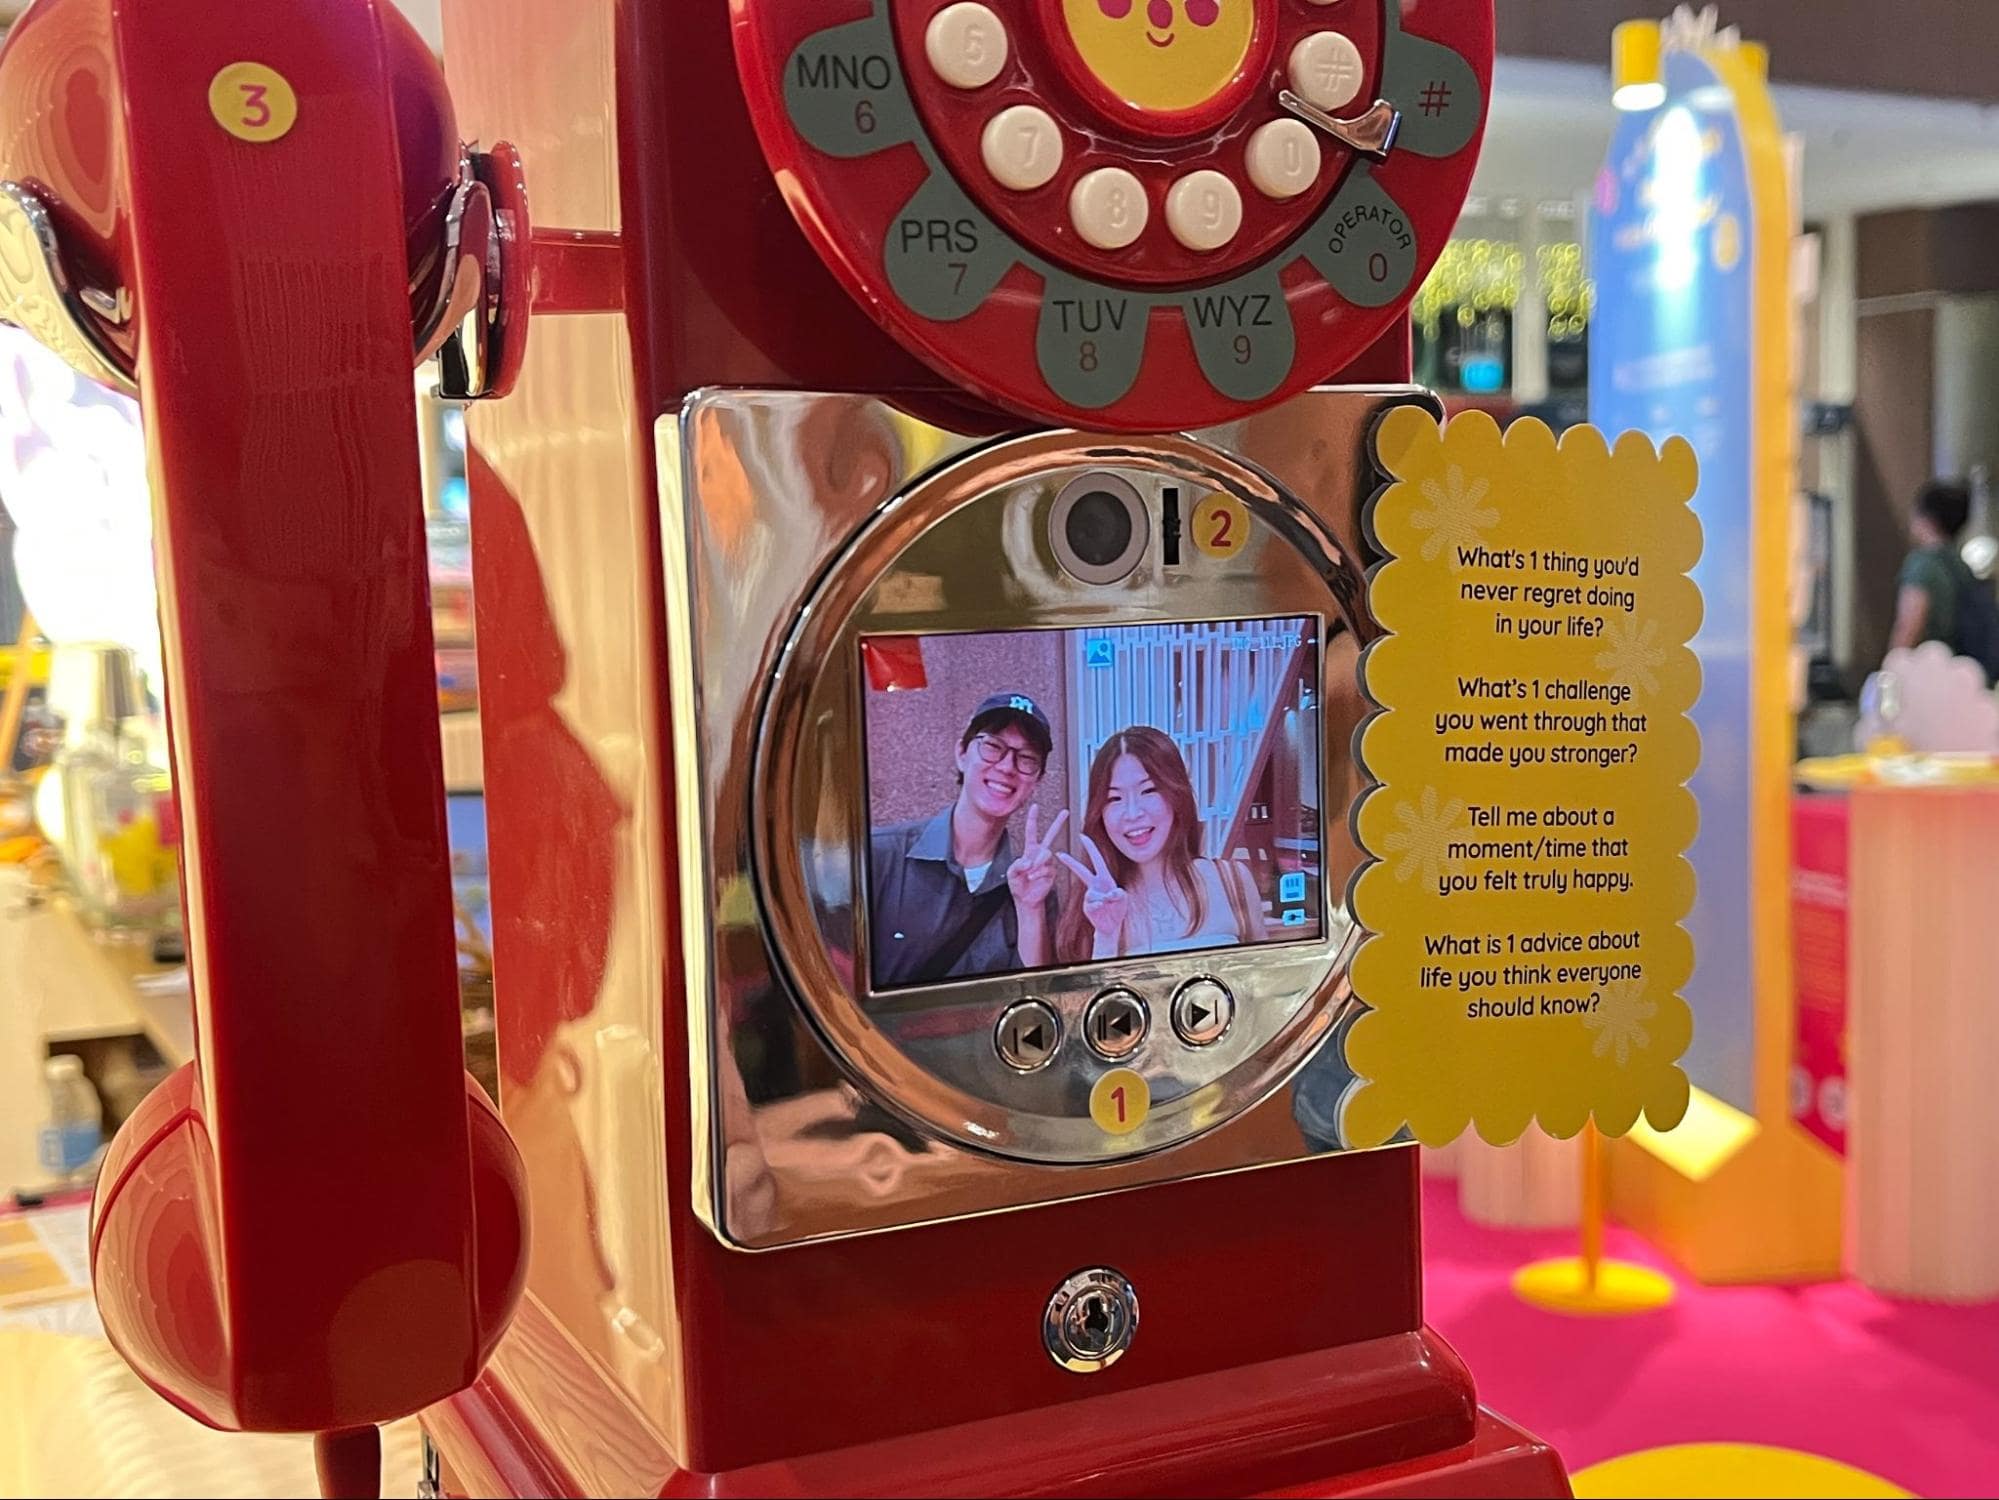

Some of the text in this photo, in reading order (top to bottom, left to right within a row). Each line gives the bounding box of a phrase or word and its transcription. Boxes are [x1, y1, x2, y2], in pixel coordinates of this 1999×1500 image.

[797, 54, 892, 91] MNO
[239, 85, 271, 127] 3
[1419, 81, 1452, 117] #
[854, 100, 876, 134] 6
[1019, 126, 1040, 168] 7
[900, 219, 979, 254] PRS
[1329, 205, 1412, 255] OPERATOR
[948, 263, 968, 296] 7
[1369, 253, 1388, 282] 0
[1052, 299, 1127, 333] TUV
[1194, 294, 1272, 328] WYZ
[1079, 341, 1098, 372] 8
[1233, 335, 1251, 364] 9
[1210, 510, 1233, 546] 2
[1458, 546, 1638, 579] What's 1 thing you'd
[1462, 584, 1634, 612] never regret doing
[1496, 613, 1603, 639] in your life?
[1458, 677, 1630, 705] What's 1 challenge
[1436, 711, 1646, 735] you went through that
[1446, 742, 1637, 768] made you stronger?
[1468, 806, 1614, 826] Tell me about a
[1449, 836, 1628, 861] moment/time that
[1440, 869, 1633, 896] you felt truly happy.
[1425, 931, 1640, 955] What is 1 advice about
[1421, 964, 1641, 991] life you think everyone
[1468, 992, 1600, 1017] should know?
[1111, 1087, 1126, 1122] 1
